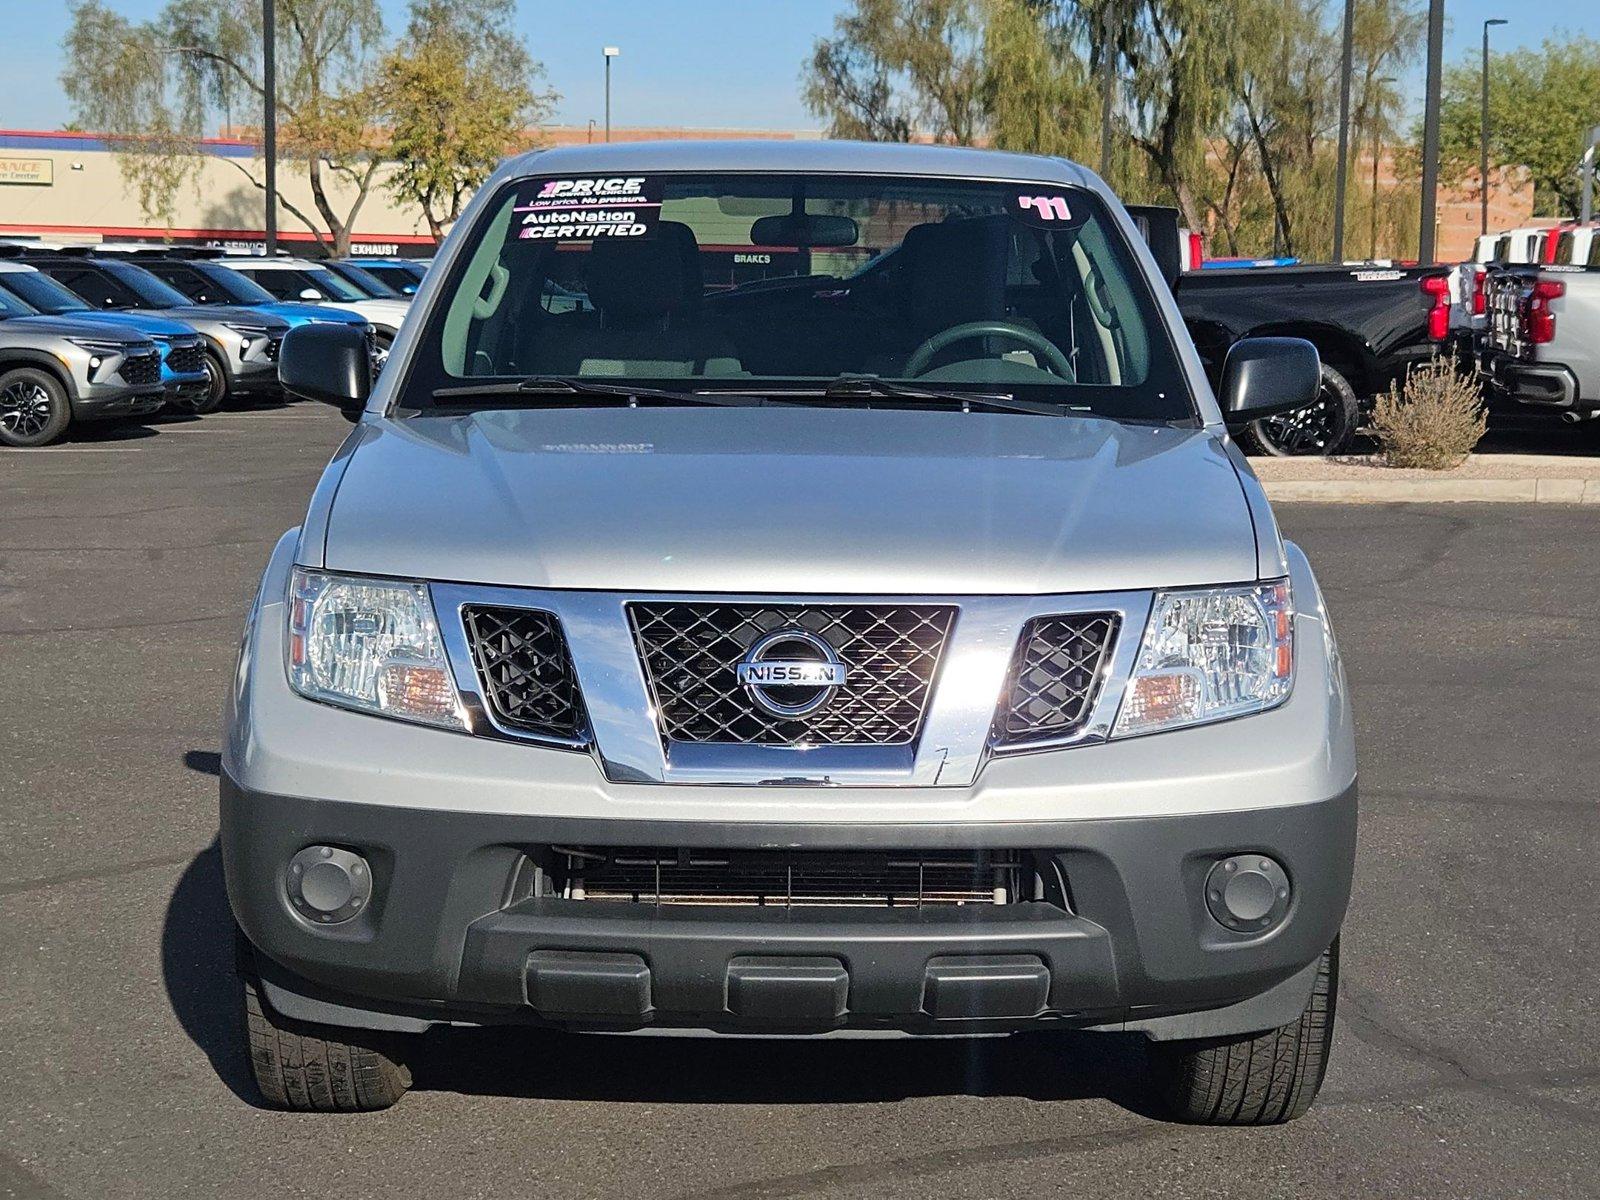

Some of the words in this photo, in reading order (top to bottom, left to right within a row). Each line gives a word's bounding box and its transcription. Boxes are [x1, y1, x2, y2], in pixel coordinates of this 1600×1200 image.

[1019, 196, 1072, 220] '11
[522, 211, 635, 224] AutoNation
[529, 224, 647, 239] CERTIFIED
[351, 244, 399, 255] EXHAUST
[734, 254, 771, 263] BRAKES
